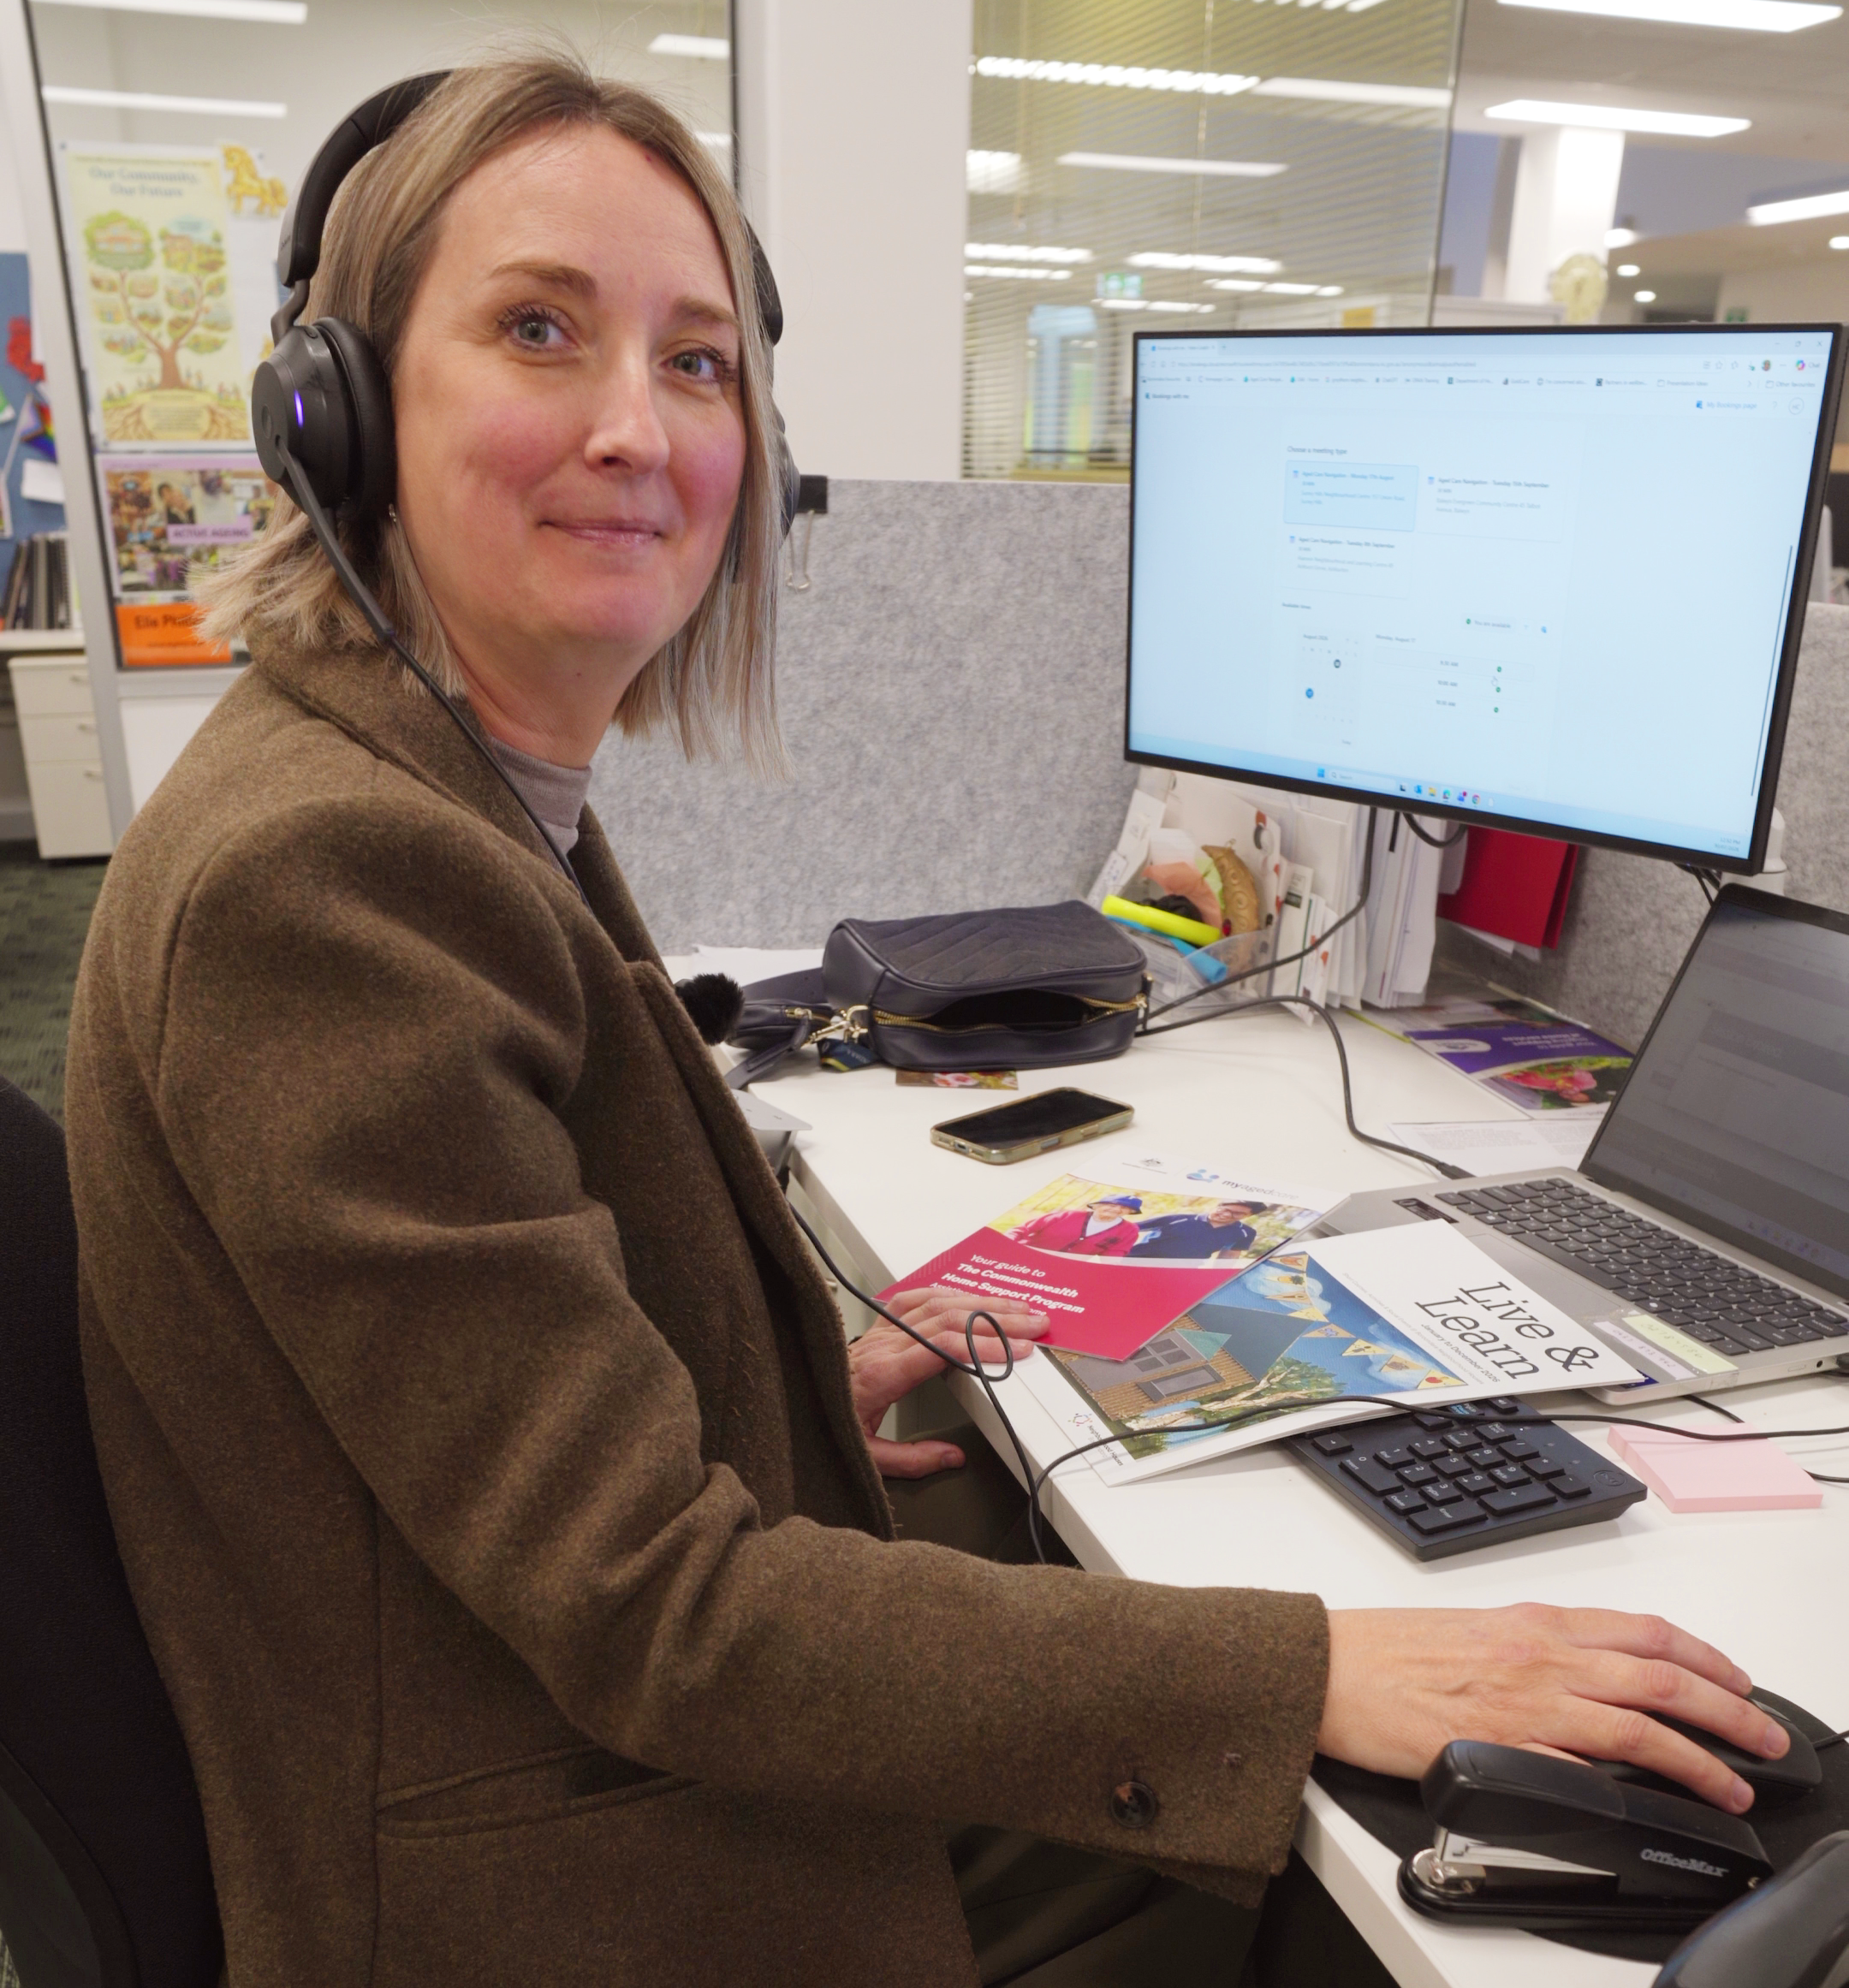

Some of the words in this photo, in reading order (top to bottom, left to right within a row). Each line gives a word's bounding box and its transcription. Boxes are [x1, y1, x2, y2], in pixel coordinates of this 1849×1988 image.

[88, 166, 115, 179] Our
[110, 181, 136, 195] Our
[139, 183, 183, 197] Future
[1312, 448, 1335, 456] meeting
[1492, 479, 1511, 488] Tuesday
[1524, 481, 1549, 490] September
[174, 528, 207, 537] ACTIVE
[211, 528, 251, 537] AGEING
[1222, 1179, 1299, 1200] myagedcare
[970, 1254, 996, 1267] Your
[995, 1261, 1032, 1275] guide
[1032, 1268, 1046, 1278] to
[957, 1263, 981, 1274] The
[980, 1269, 1079, 1298] Commonwealth
[941, 1273, 978, 1287] Home
[978, 1282, 1032, 1302] Support
[1029, 1294, 1085, 1314] Program
[1458, 1281, 1555, 1339] Live
[1544, 1346, 1599, 1373] &
[1414, 1296, 1540, 1380] Learn
[1421, 1323, 1445, 1342] January
[1444, 1339, 1454, 1348] to
[1450, 1345, 1483, 1373] December
[1481, 1369, 1501, 1383] 2026
[1489, 1424, 1500, 1434] Lock
[1494, 1422, 1505, 1433] Num
[1447, 1434, 1462, 1445] Home
[1110, 1451, 1124, 1466] Houses
[1379, 1451, 1391, 1459] End
[1346, 1459, 1359, 1470] Insert
[1495, 1469, 1508, 1480] PgUp
[1426, 1487, 1439, 1497] PgDn
[1390, 1495, 1406, 1506] Delete
[1439, 1508, 1453, 1518] Enter
[1640, 1849, 1730, 1878] OfficeMax
